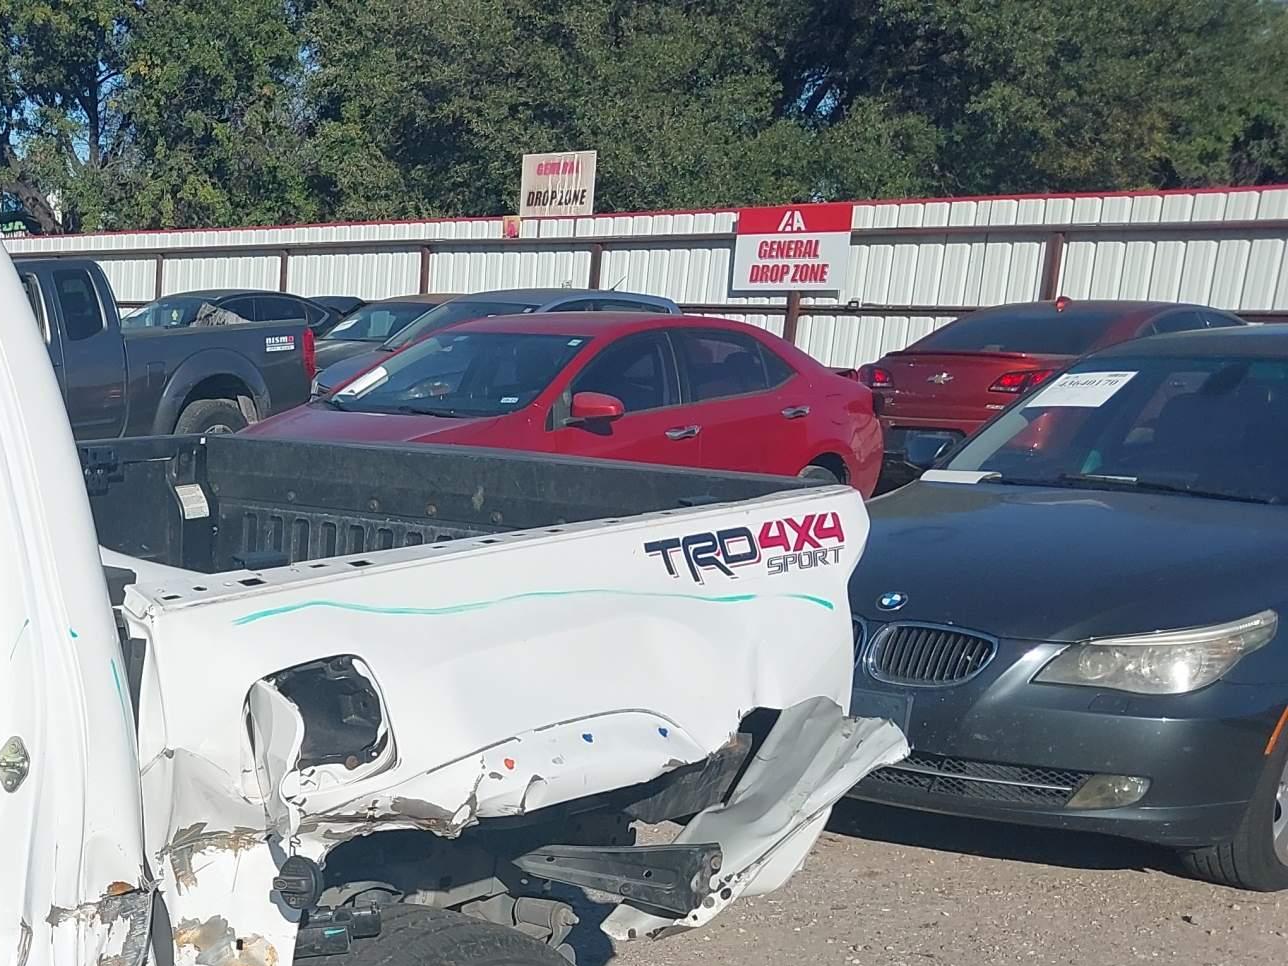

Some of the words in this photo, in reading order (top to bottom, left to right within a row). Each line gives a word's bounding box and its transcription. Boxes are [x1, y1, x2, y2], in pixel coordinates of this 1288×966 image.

[527, 190, 557, 207] DROP
[758, 240, 820, 260] GENERAL
[749, 264, 791, 283] DROP
[791, 263, 829, 283] ZONE
[643, 526, 762, 586] TRD
[767, 546, 845, 577] SPORT
